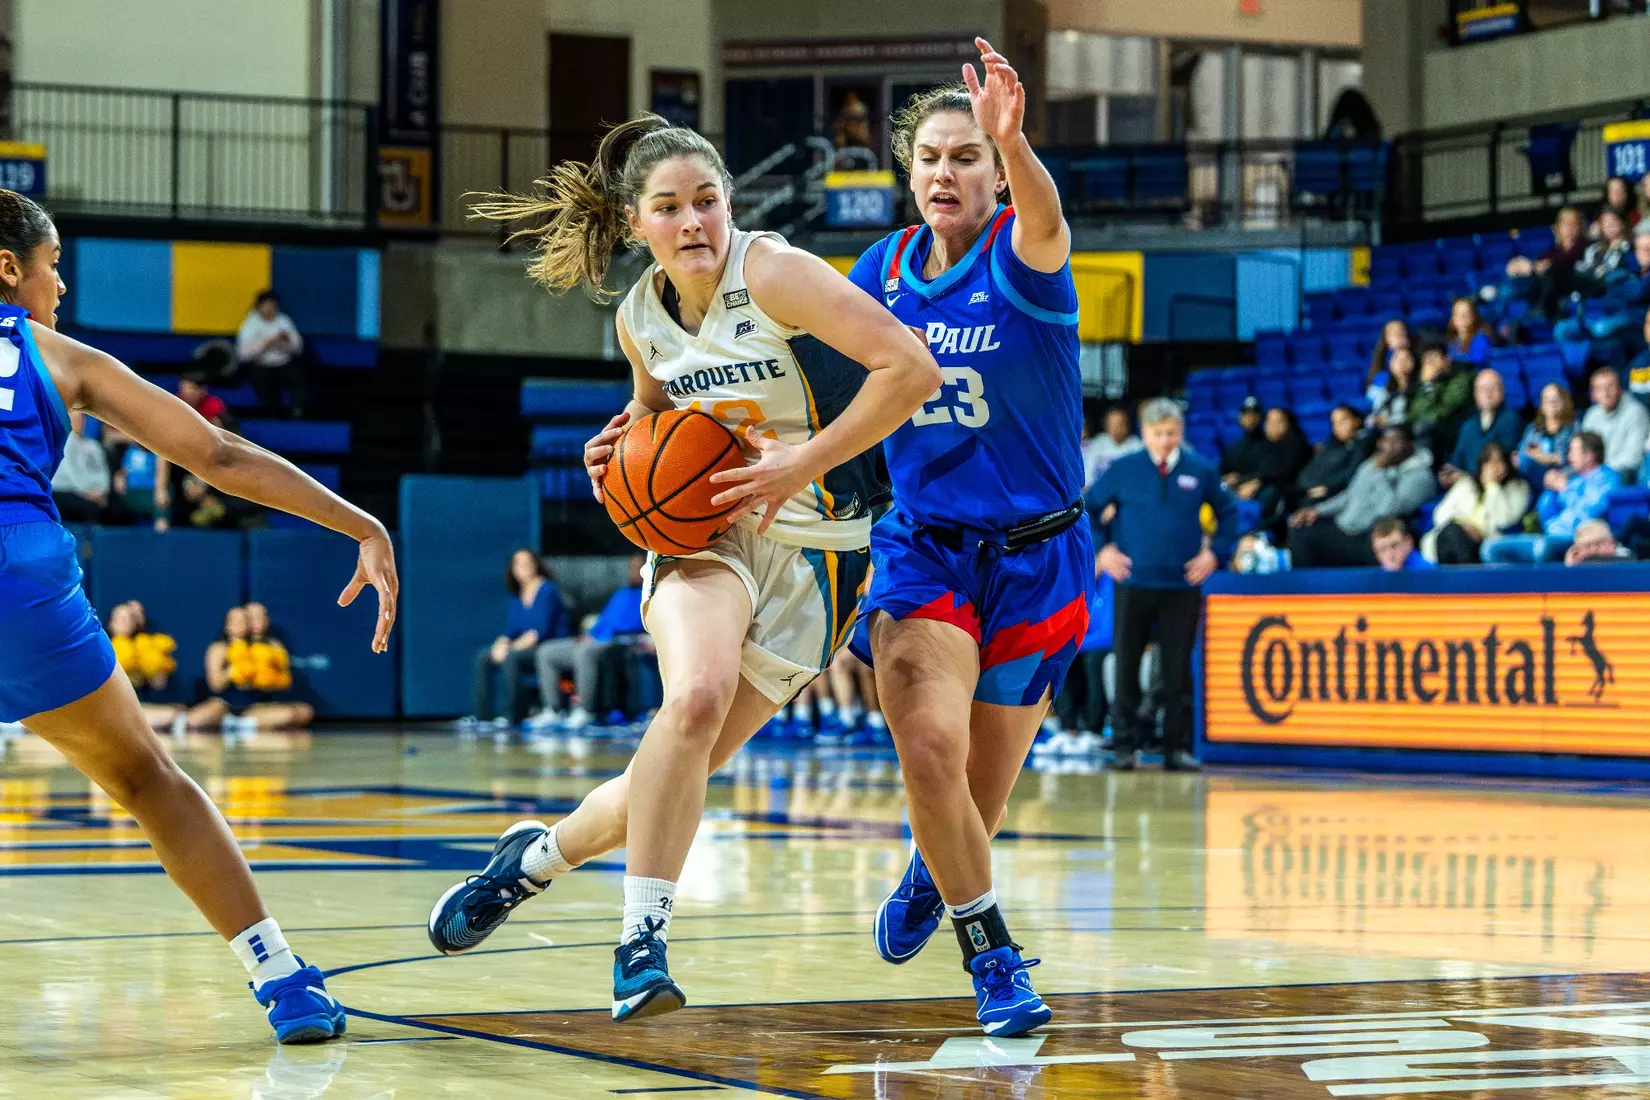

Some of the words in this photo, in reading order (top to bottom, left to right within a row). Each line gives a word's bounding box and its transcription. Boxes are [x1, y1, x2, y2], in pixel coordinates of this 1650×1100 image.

[1614, 143, 1646, 175] 101
[838, 191, 884, 220] 120
[663, 359, 786, 397] ARQUETTE
[1241, 614, 1558, 725] Continental
